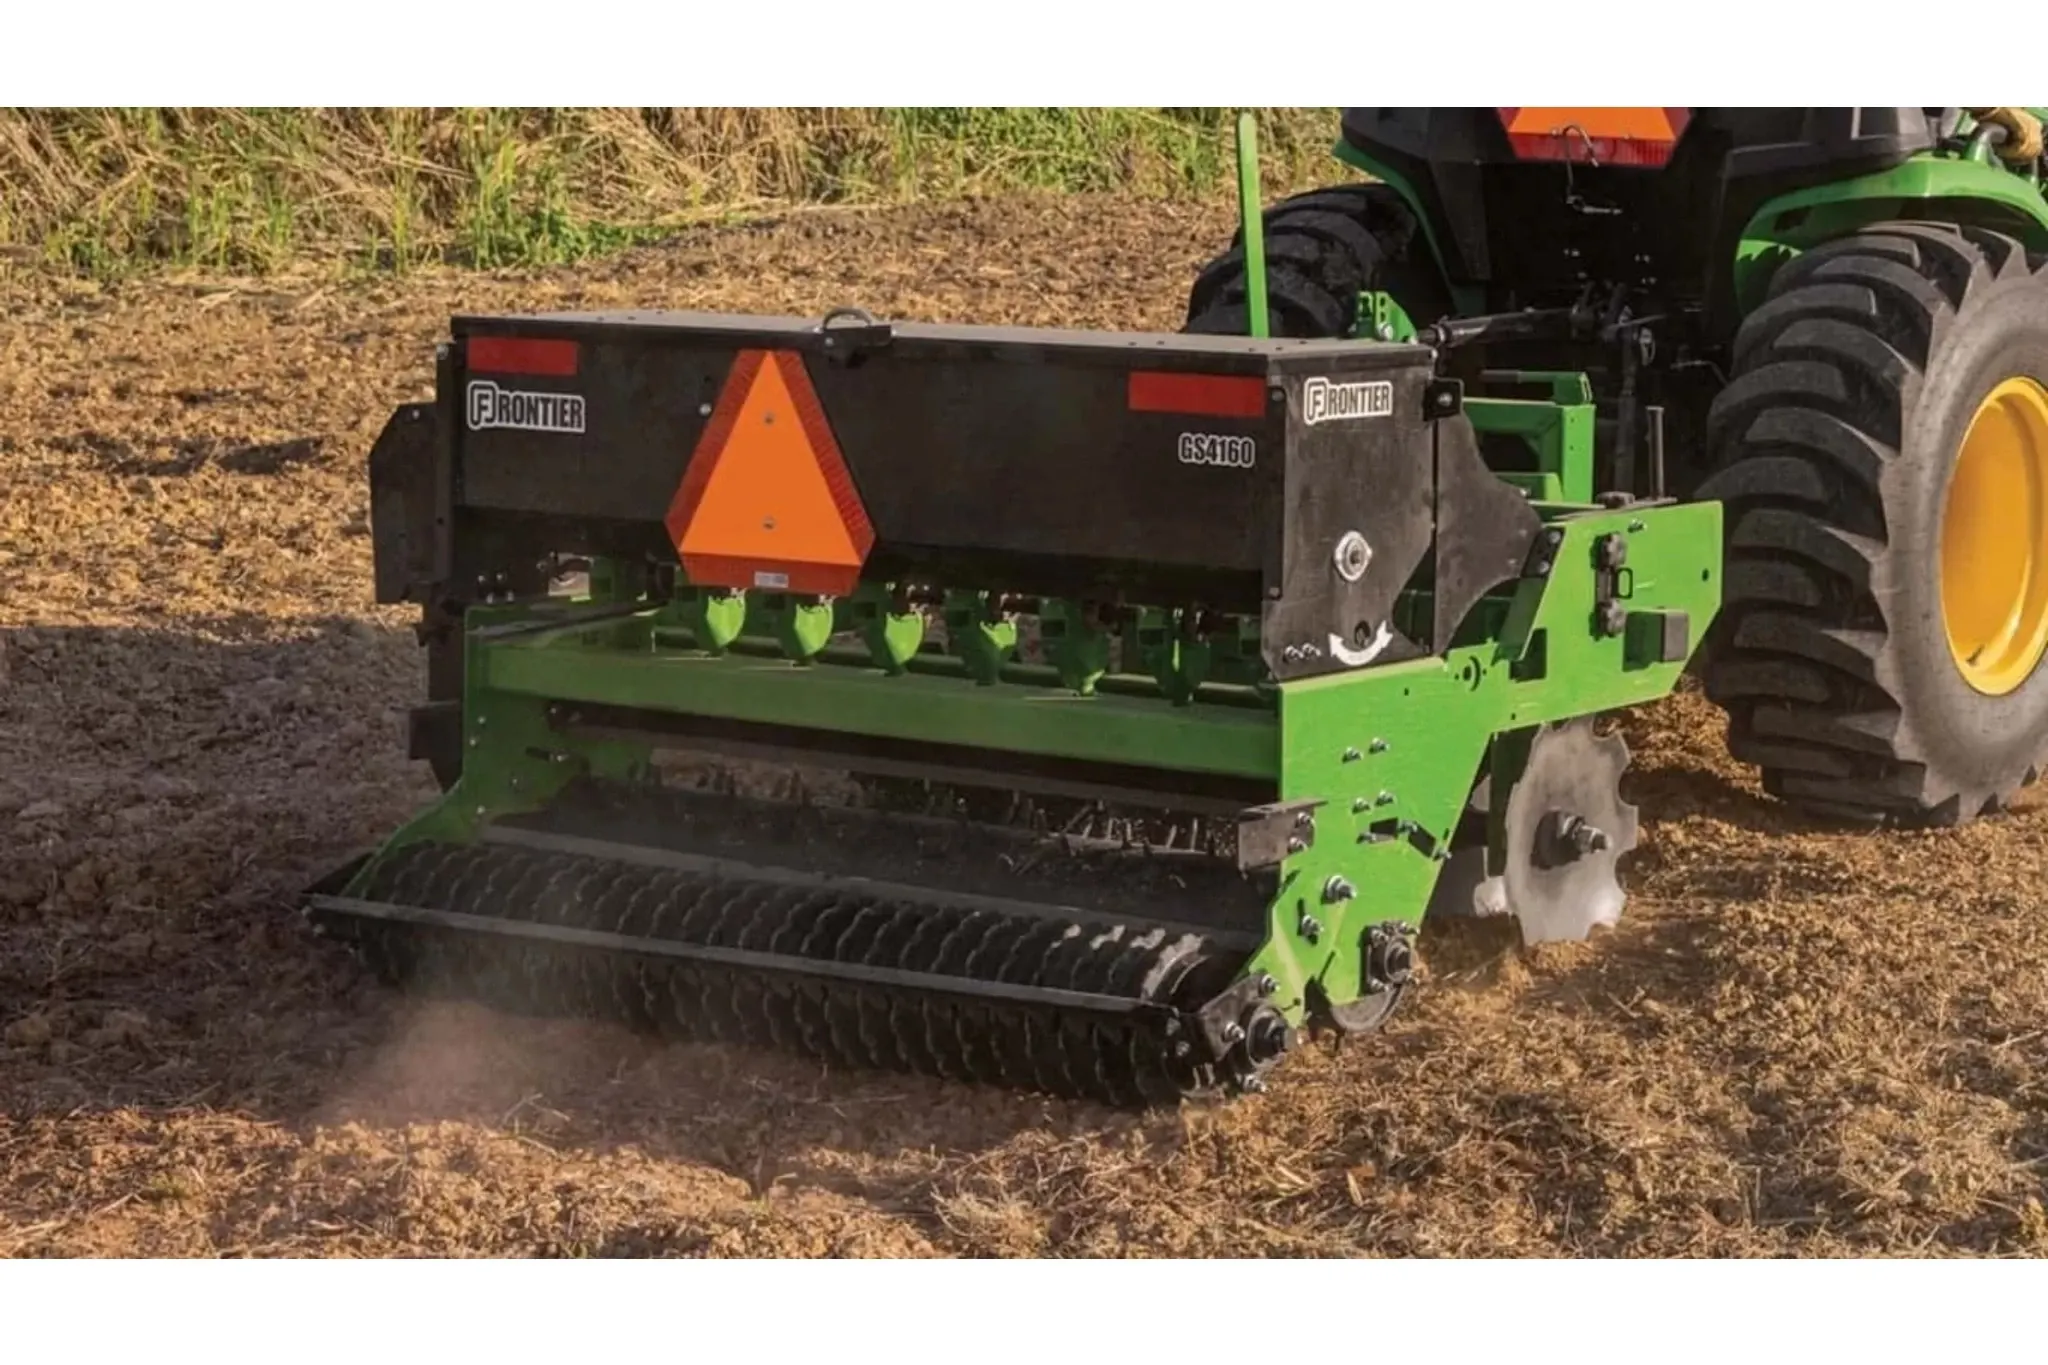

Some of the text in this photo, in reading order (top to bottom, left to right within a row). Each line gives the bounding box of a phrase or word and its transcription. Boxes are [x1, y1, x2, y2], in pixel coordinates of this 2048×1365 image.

[468, 381, 585, 432] FRONTIER
[1304, 377, 1392, 424] FRONTIER
[1179, 433, 1255, 467] GS4160
